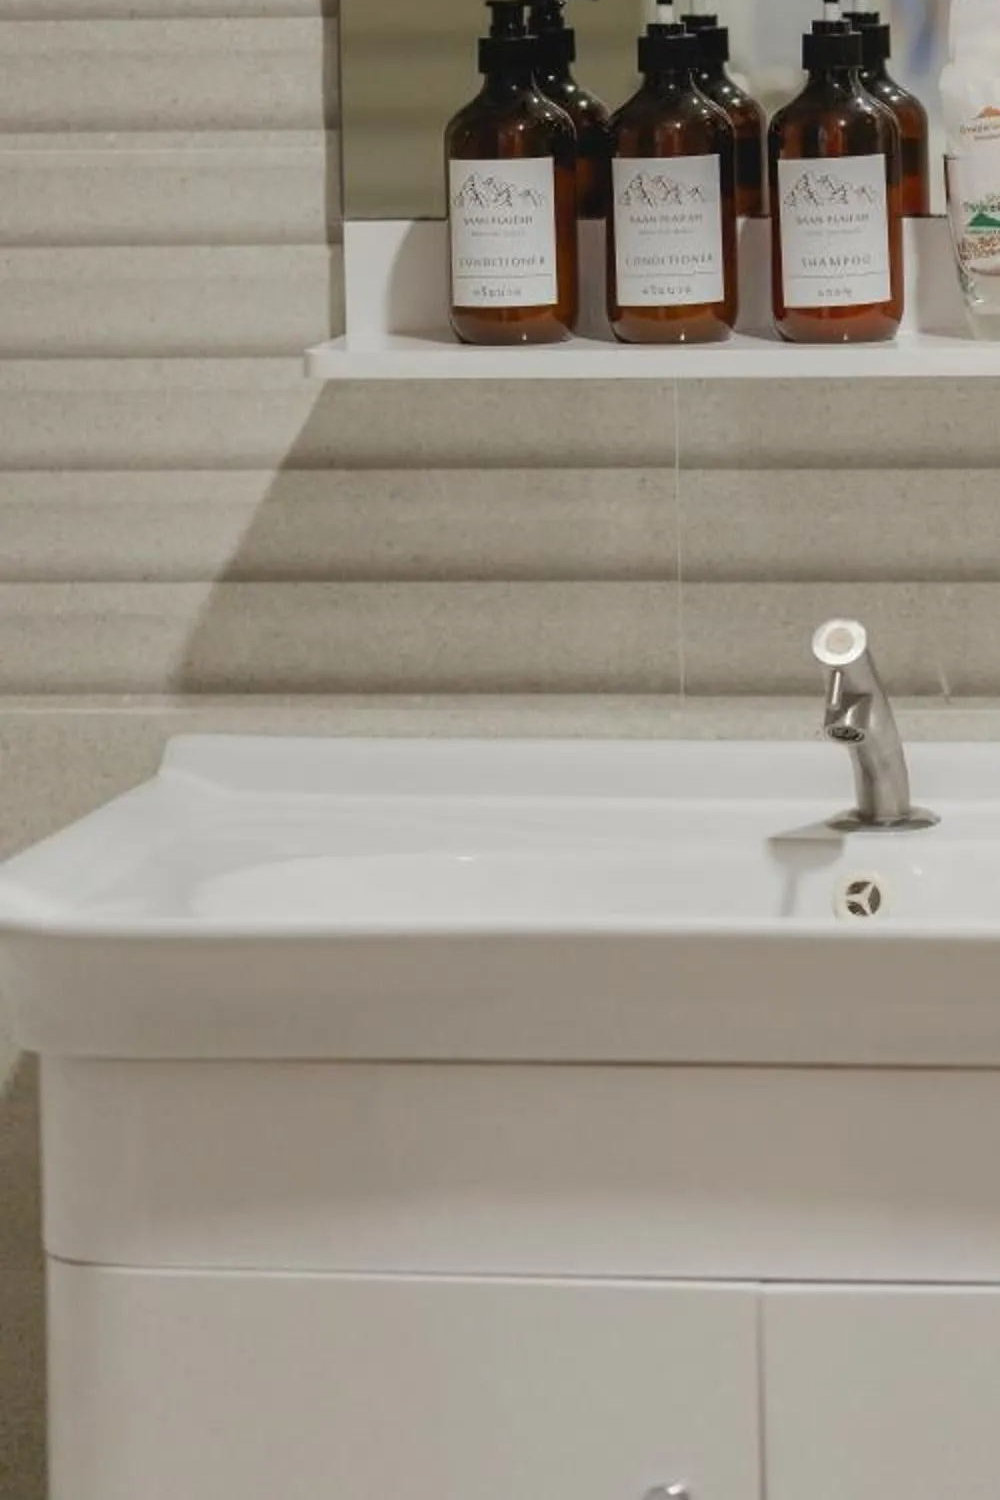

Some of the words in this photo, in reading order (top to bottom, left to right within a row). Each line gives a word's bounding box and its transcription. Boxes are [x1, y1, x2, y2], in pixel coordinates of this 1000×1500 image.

[458, 255, 546, 269] CONDITIONER
[624, 252, 713, 267] CONDITIONER
[800, 254, 872, 269] SHAMPOO
